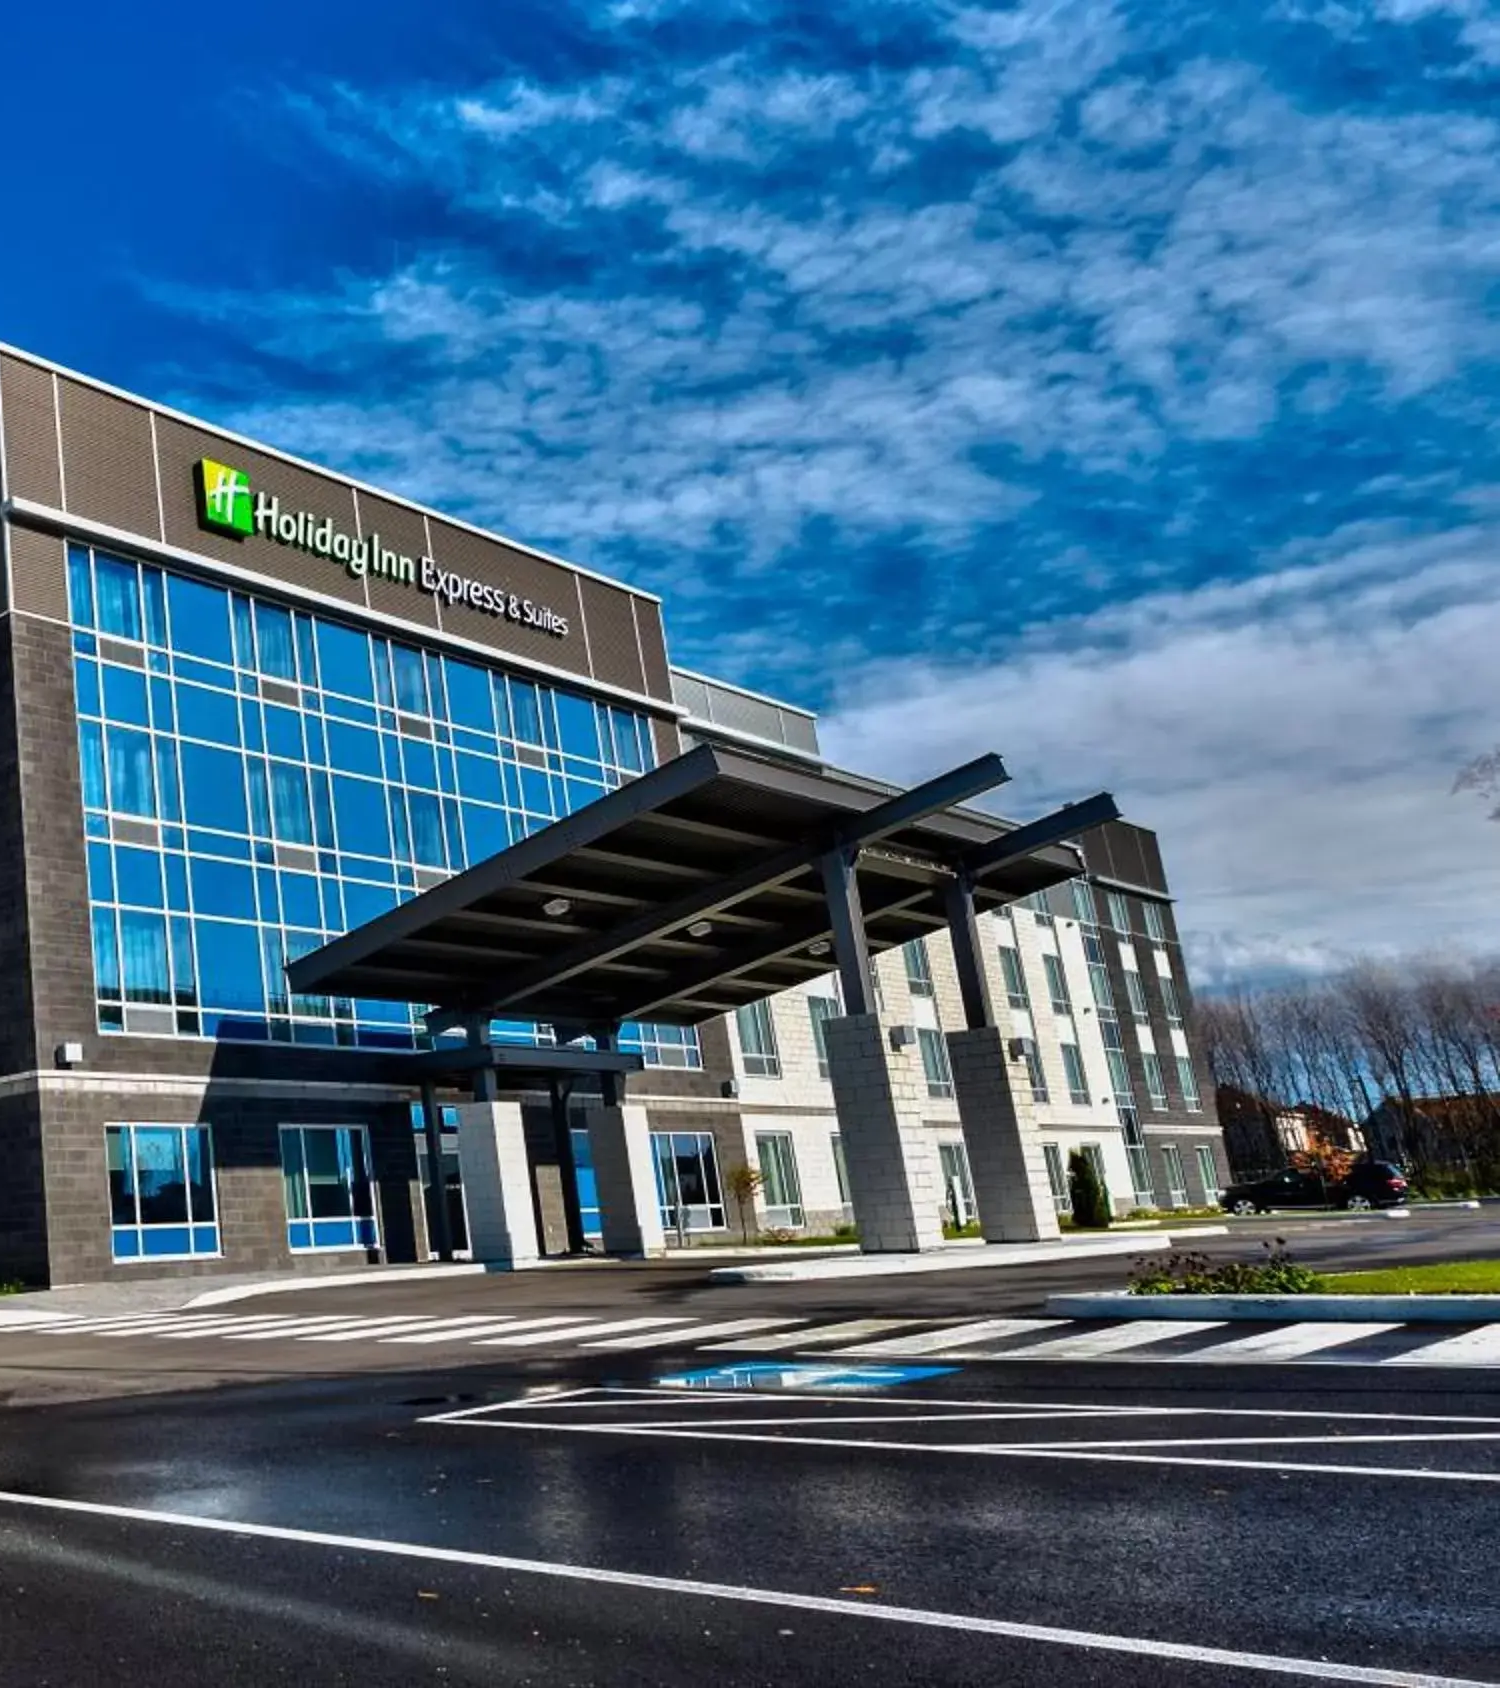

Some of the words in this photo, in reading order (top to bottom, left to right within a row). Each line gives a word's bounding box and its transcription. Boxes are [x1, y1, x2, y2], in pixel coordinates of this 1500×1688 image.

[254, 491, 368, 575] Holiday
[373, 533, 415, 582] Inn
[421, 555, 505, 613] Express
[508, 595, 521, 618] &
[523, 600, 569, 635] Suites
